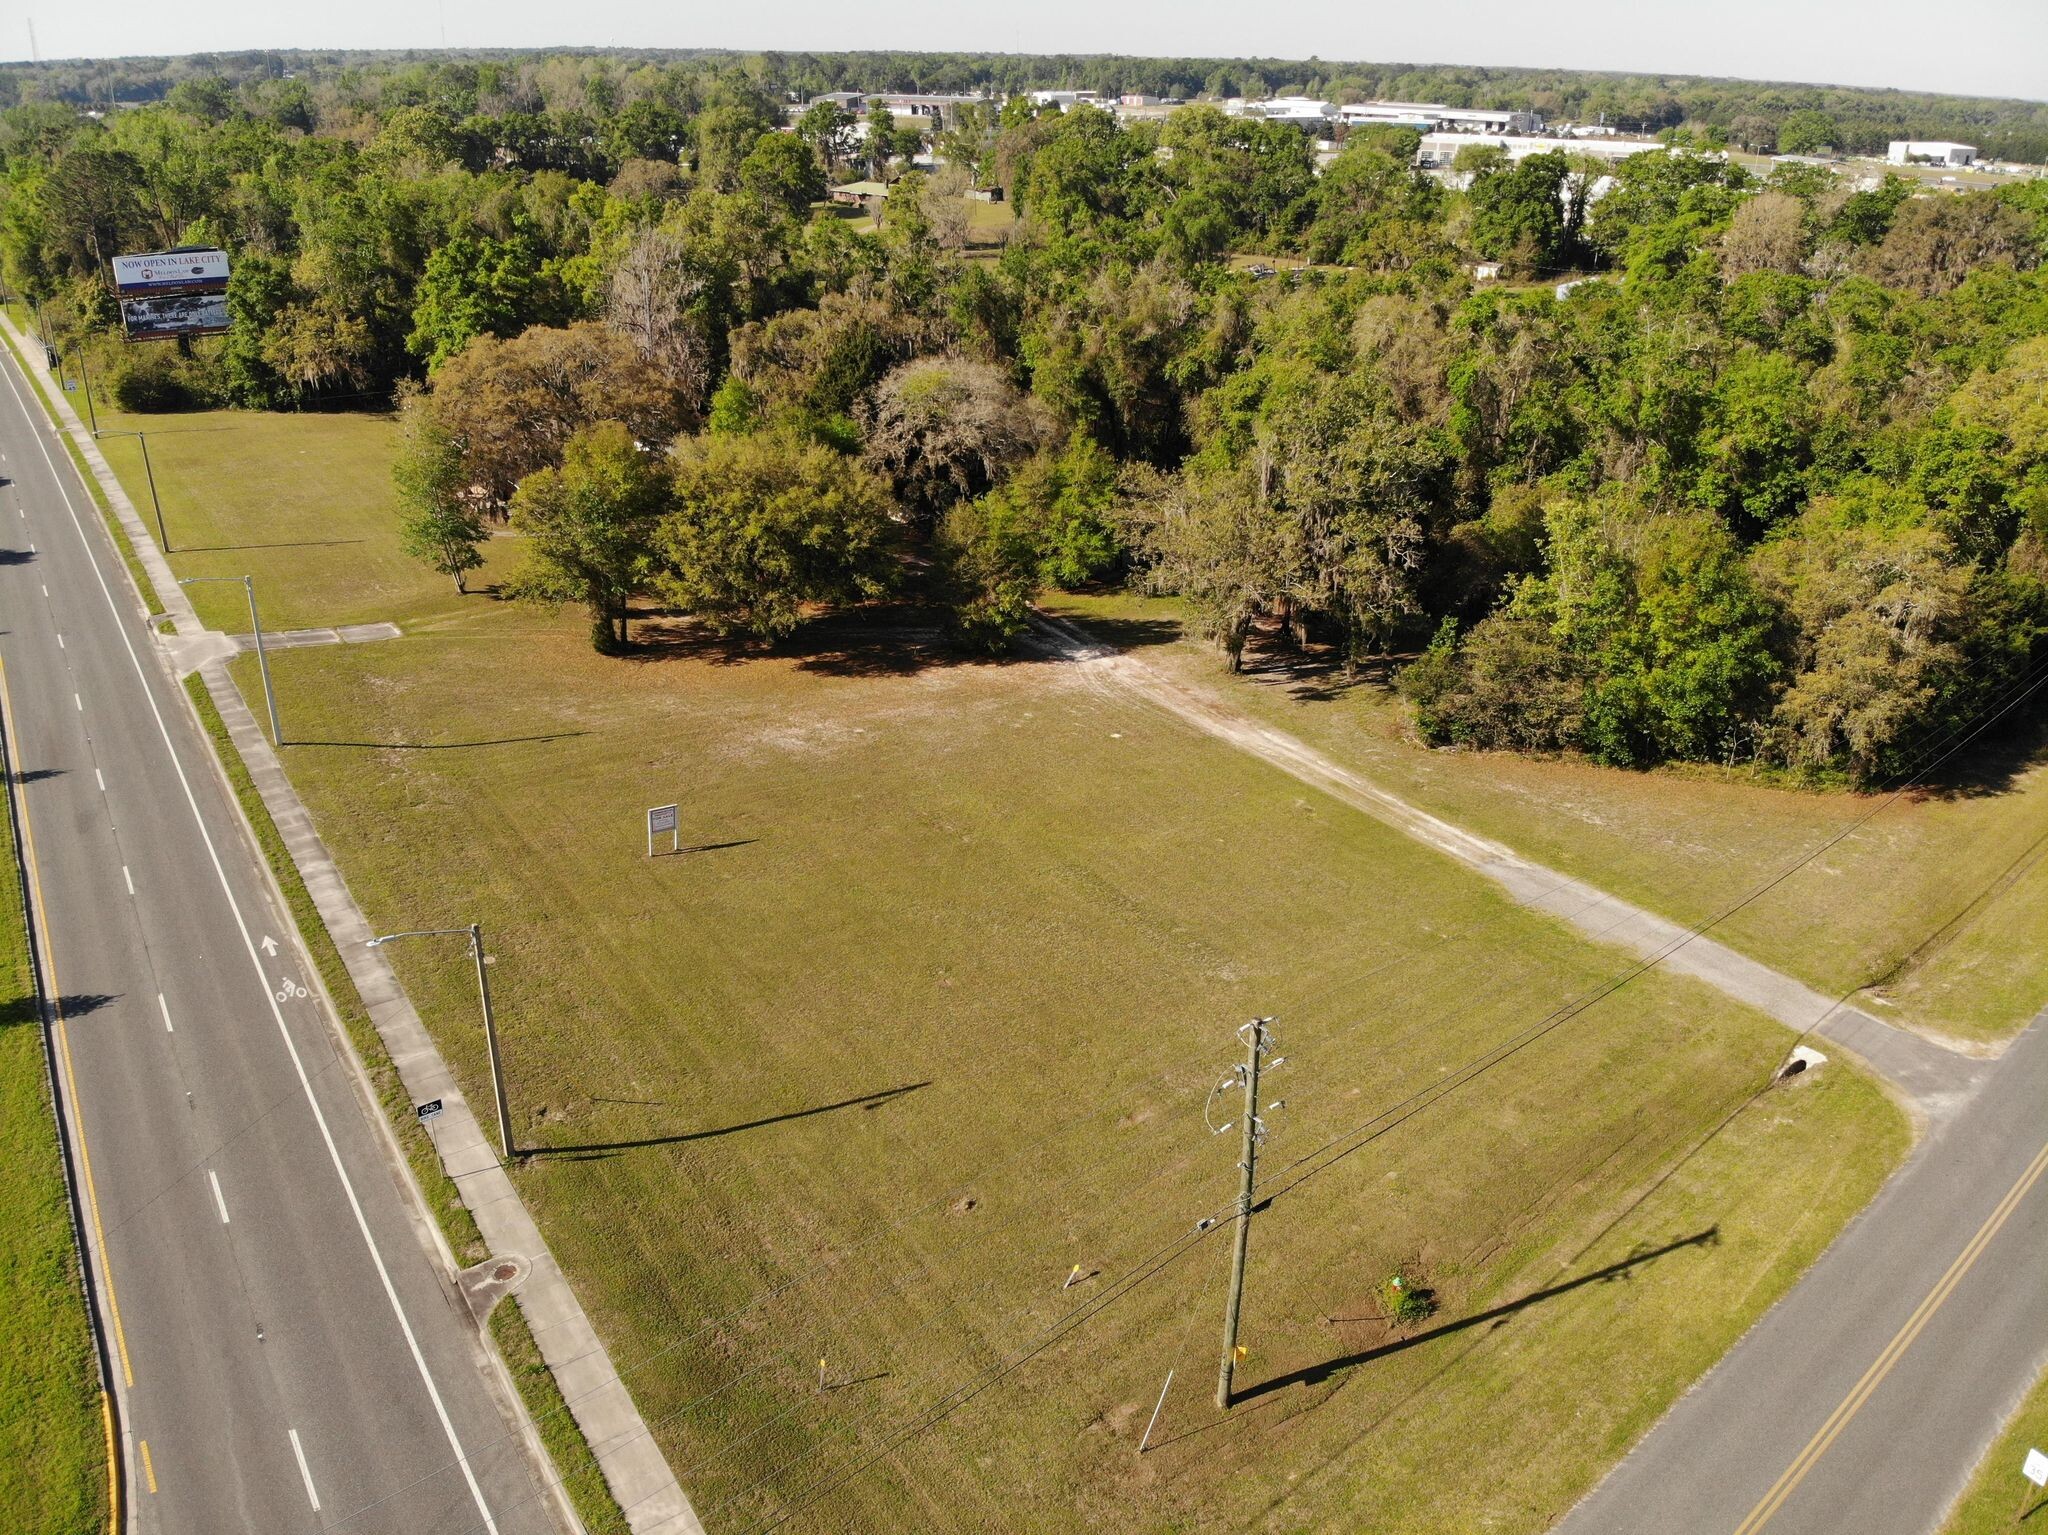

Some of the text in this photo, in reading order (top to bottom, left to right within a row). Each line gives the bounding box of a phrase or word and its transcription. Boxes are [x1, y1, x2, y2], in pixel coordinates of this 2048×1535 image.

[122, 255, 222, 269] NOW OPEN IN LAKE CITY
